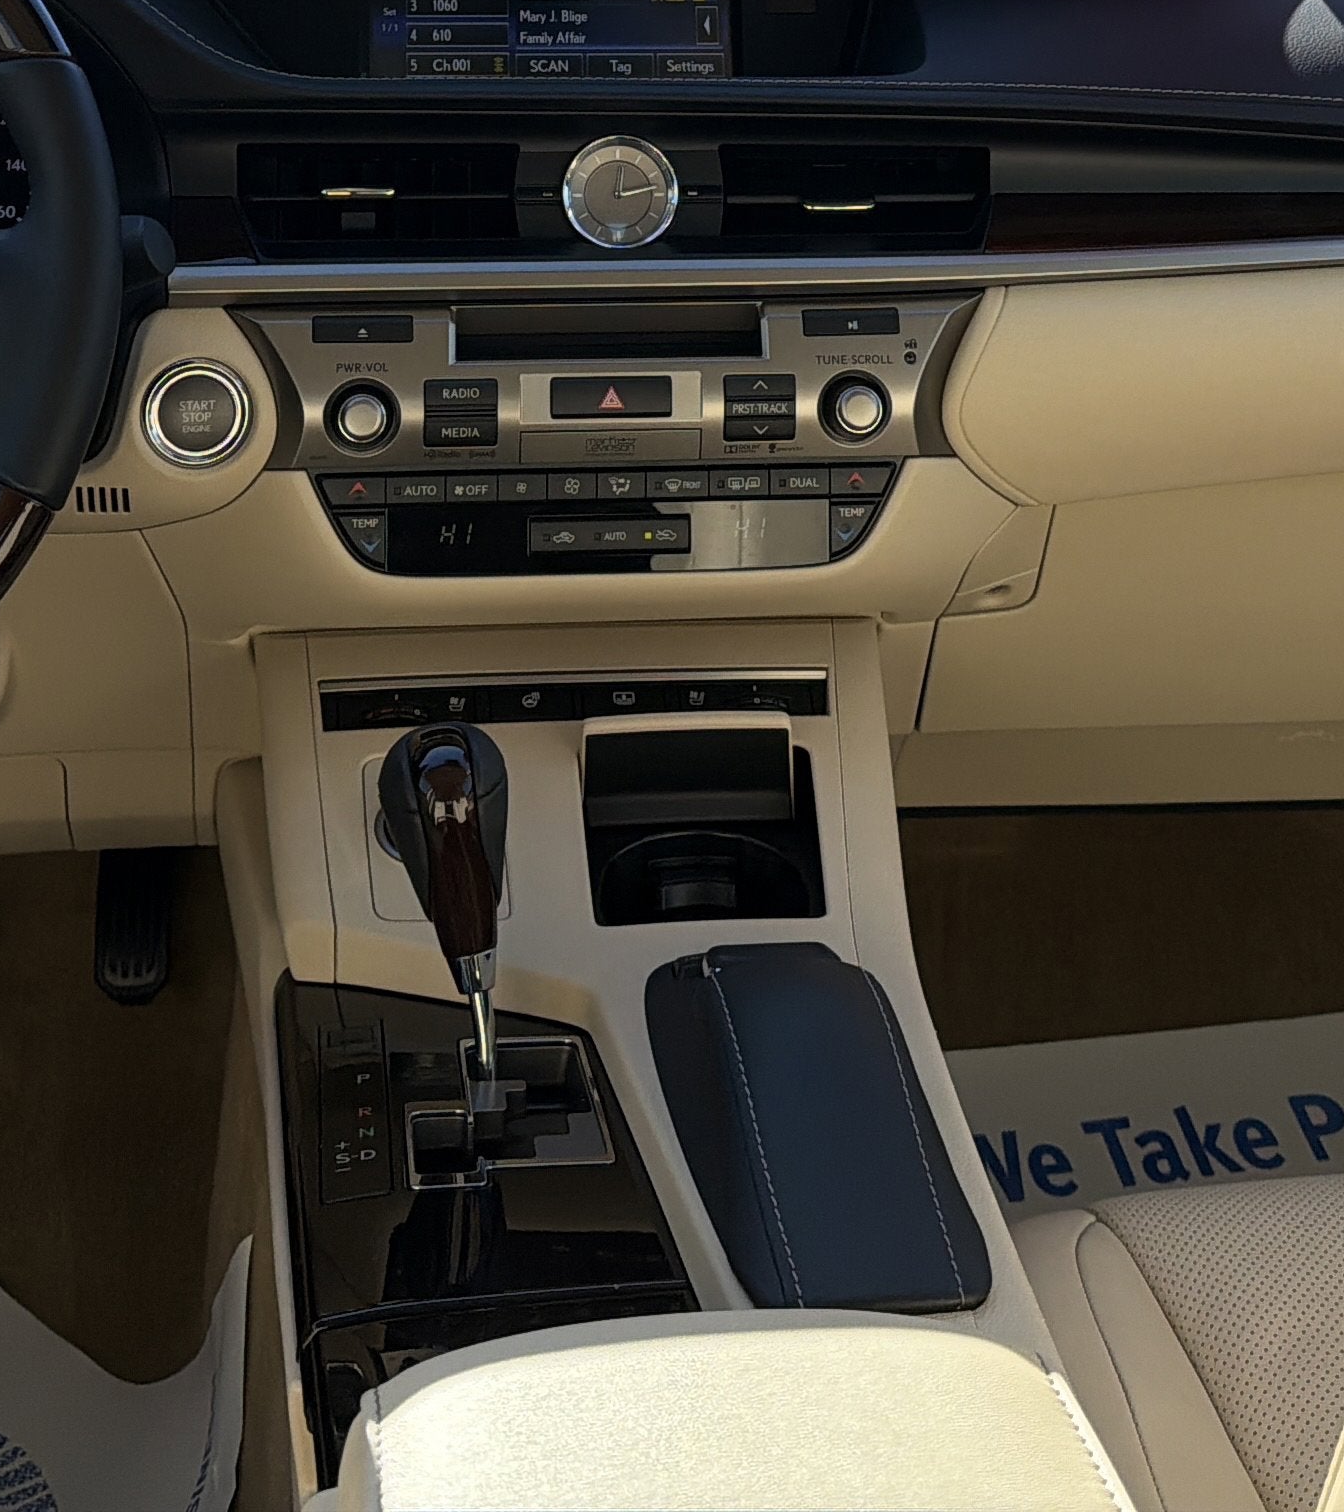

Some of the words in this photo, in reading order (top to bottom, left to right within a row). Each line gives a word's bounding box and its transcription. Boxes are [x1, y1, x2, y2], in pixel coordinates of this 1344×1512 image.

[410, 0, 417, 12] 3
[432, 0, 459, 12] 1060
[519, 10, 547, 25] Mary
[561, 10, 589, 25] Blige
[409, 29, 417, 42] 4
[432, 29, 452, 42] 610
[519, 31, 554, 46] Family
[556, 31, 587, 44] Affair
[410, 59, 417, 72] 5
[529, 60, 569, 73] SCAN
[609, 60, 632, 75] Tag
[666, 60, 715, 75] Settings
[442, 388, 480, 400] RADIO
[178, 400, 216, 412] START
[182, 412, 212, 423] STOP
[182, 425, 212, 433] ENGINE
[441, 427, 480, 438] MEDIA
[789, 477, 819, 488] DUAL
[404, 486, 437, 496] AUTO
[466, 485, 489, 496] OFF
[839, 507, 865, 517] TEMP
[351, 519, 379, 528] TEMP
[604, 531, 627, 541] AUTO
[357, 1073, 371, 1085] P
[358, 1107, 373, 1118] R
[359, 1127, 374, 1138] N
[1081, 1105, 1286, 1188] Take
[336, 1152, 351, 1164] S
[360, 1149, 376, 1161] D
